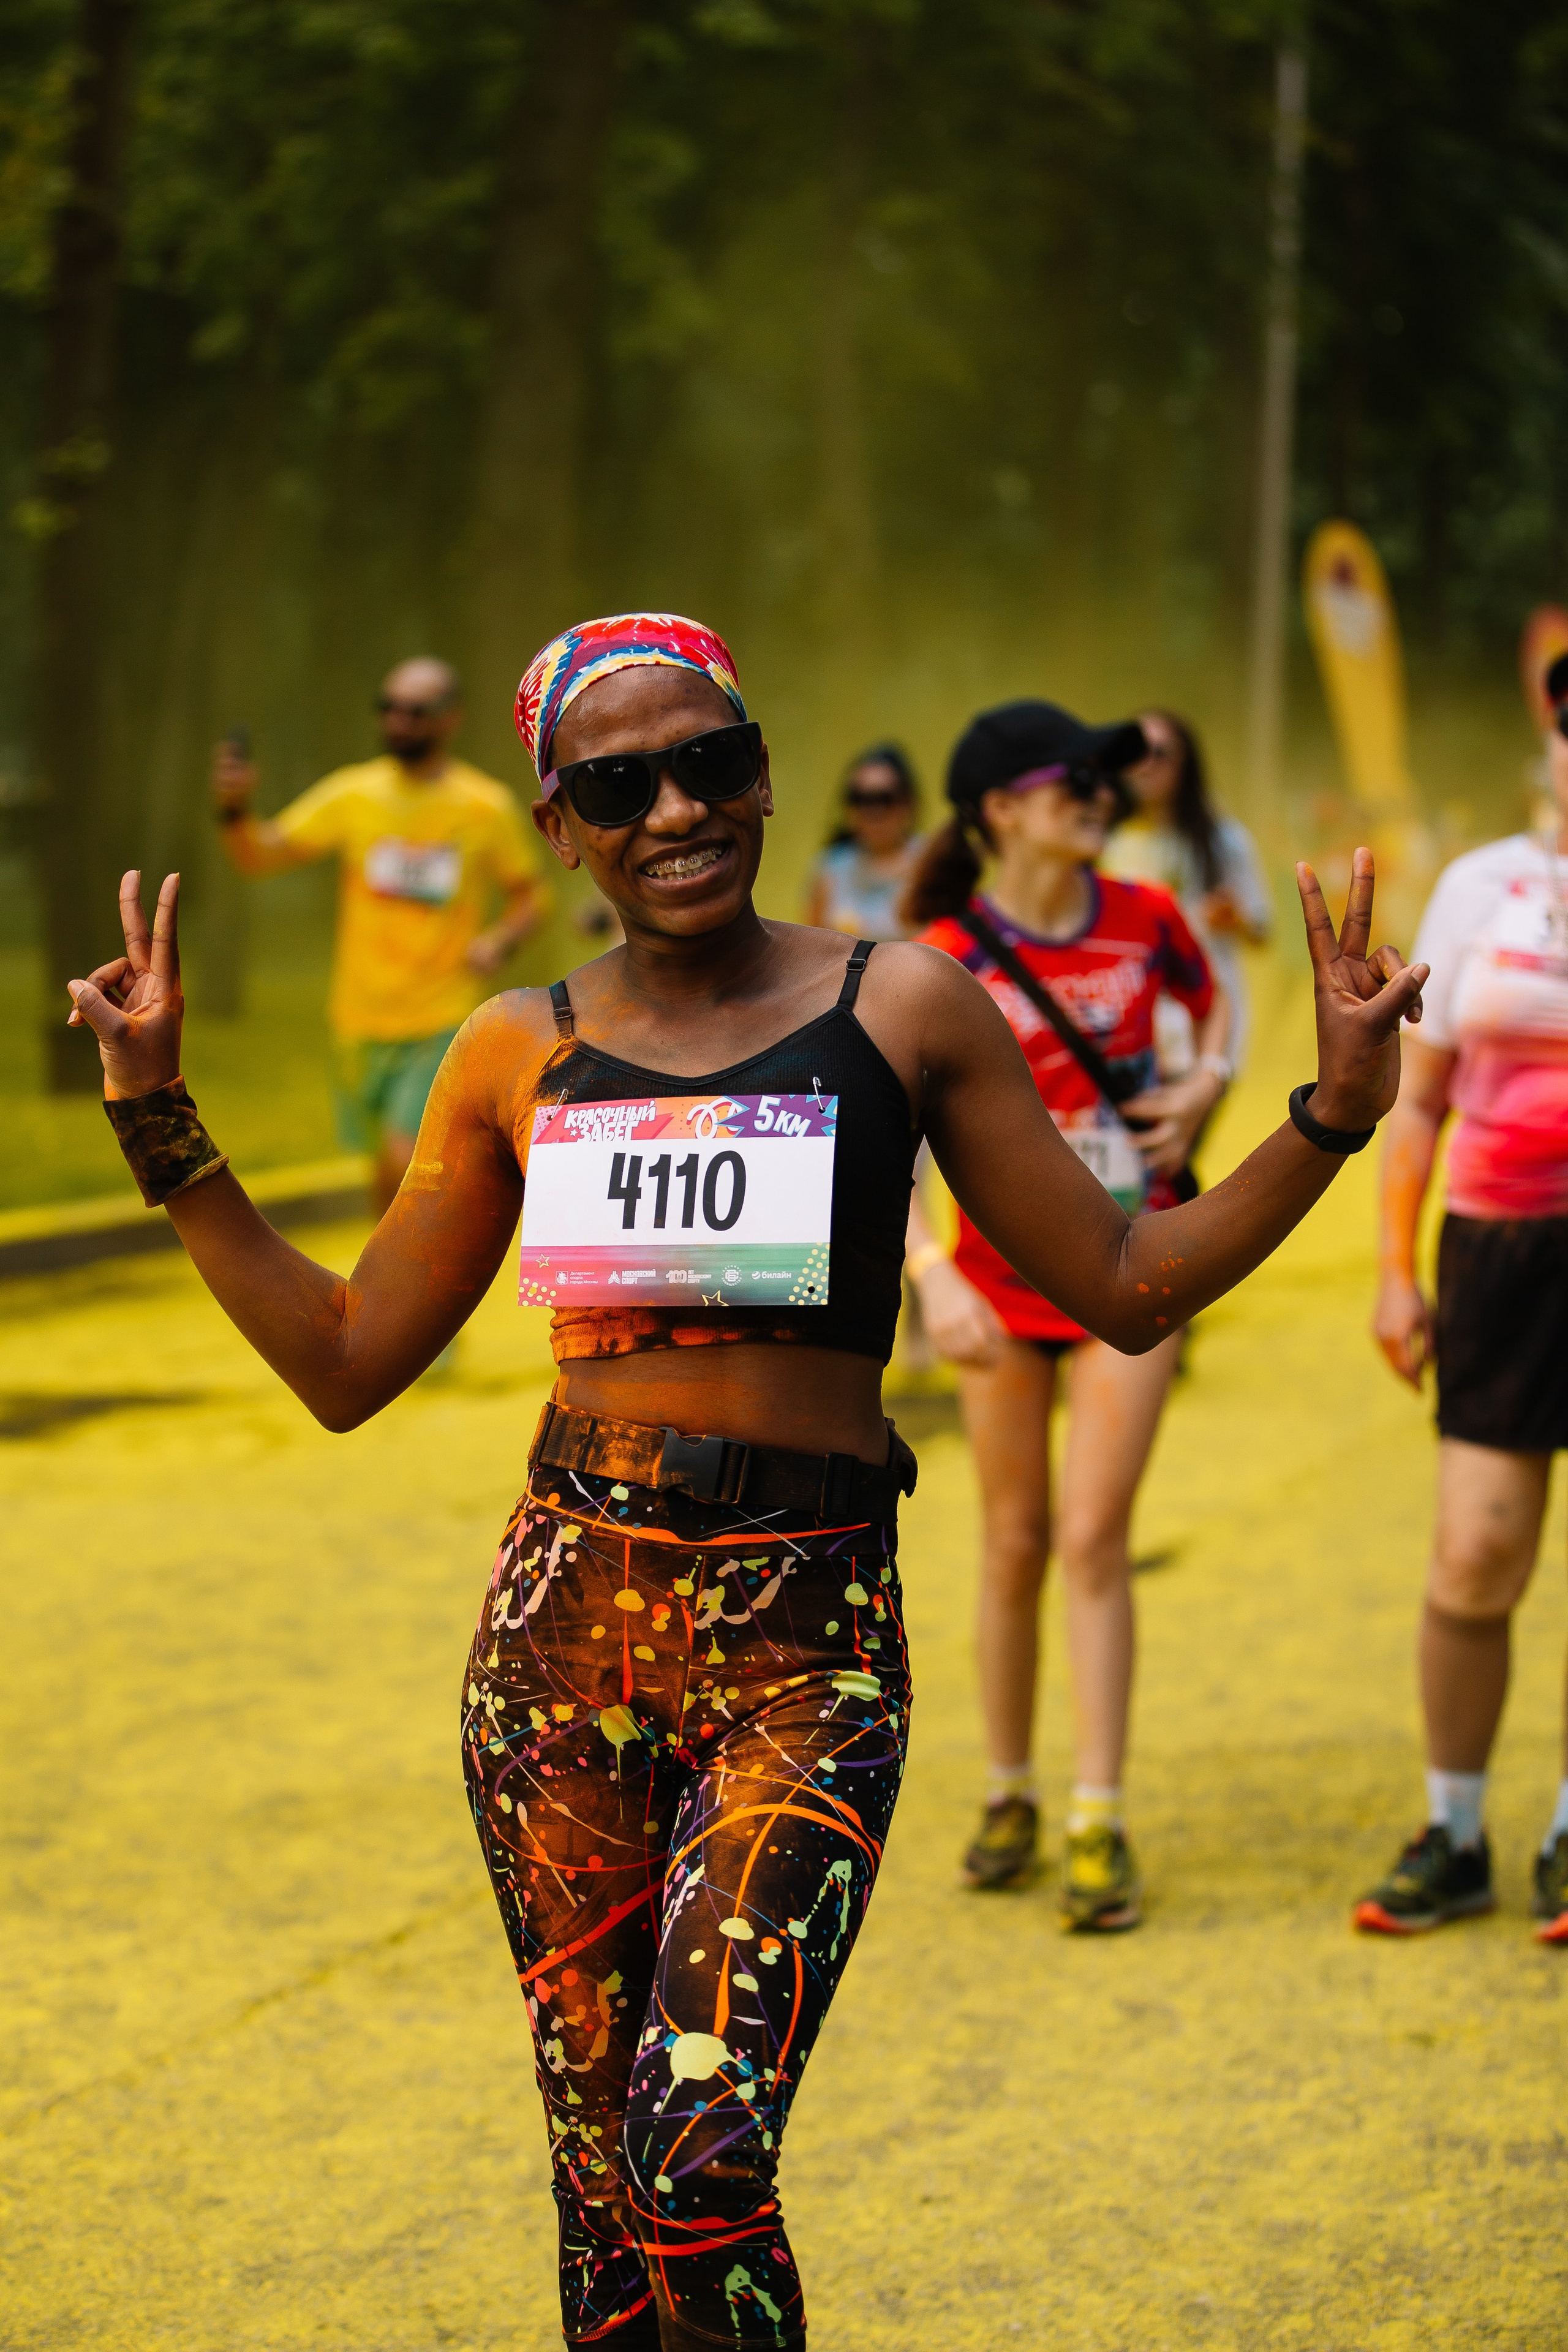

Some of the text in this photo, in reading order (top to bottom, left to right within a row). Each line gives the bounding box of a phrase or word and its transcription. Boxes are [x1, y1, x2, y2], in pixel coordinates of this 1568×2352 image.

[564, 1100, 657, 1129] КРАСОЧНЫЙ
[576, 1120, 640, 1142] ЗАБЕГ
[607, 1150, 747, 1232] 4110
[621, 1268, 656, 1278] МОСКОВСКИЙ
[665, 1270, 687, 1284] 100
